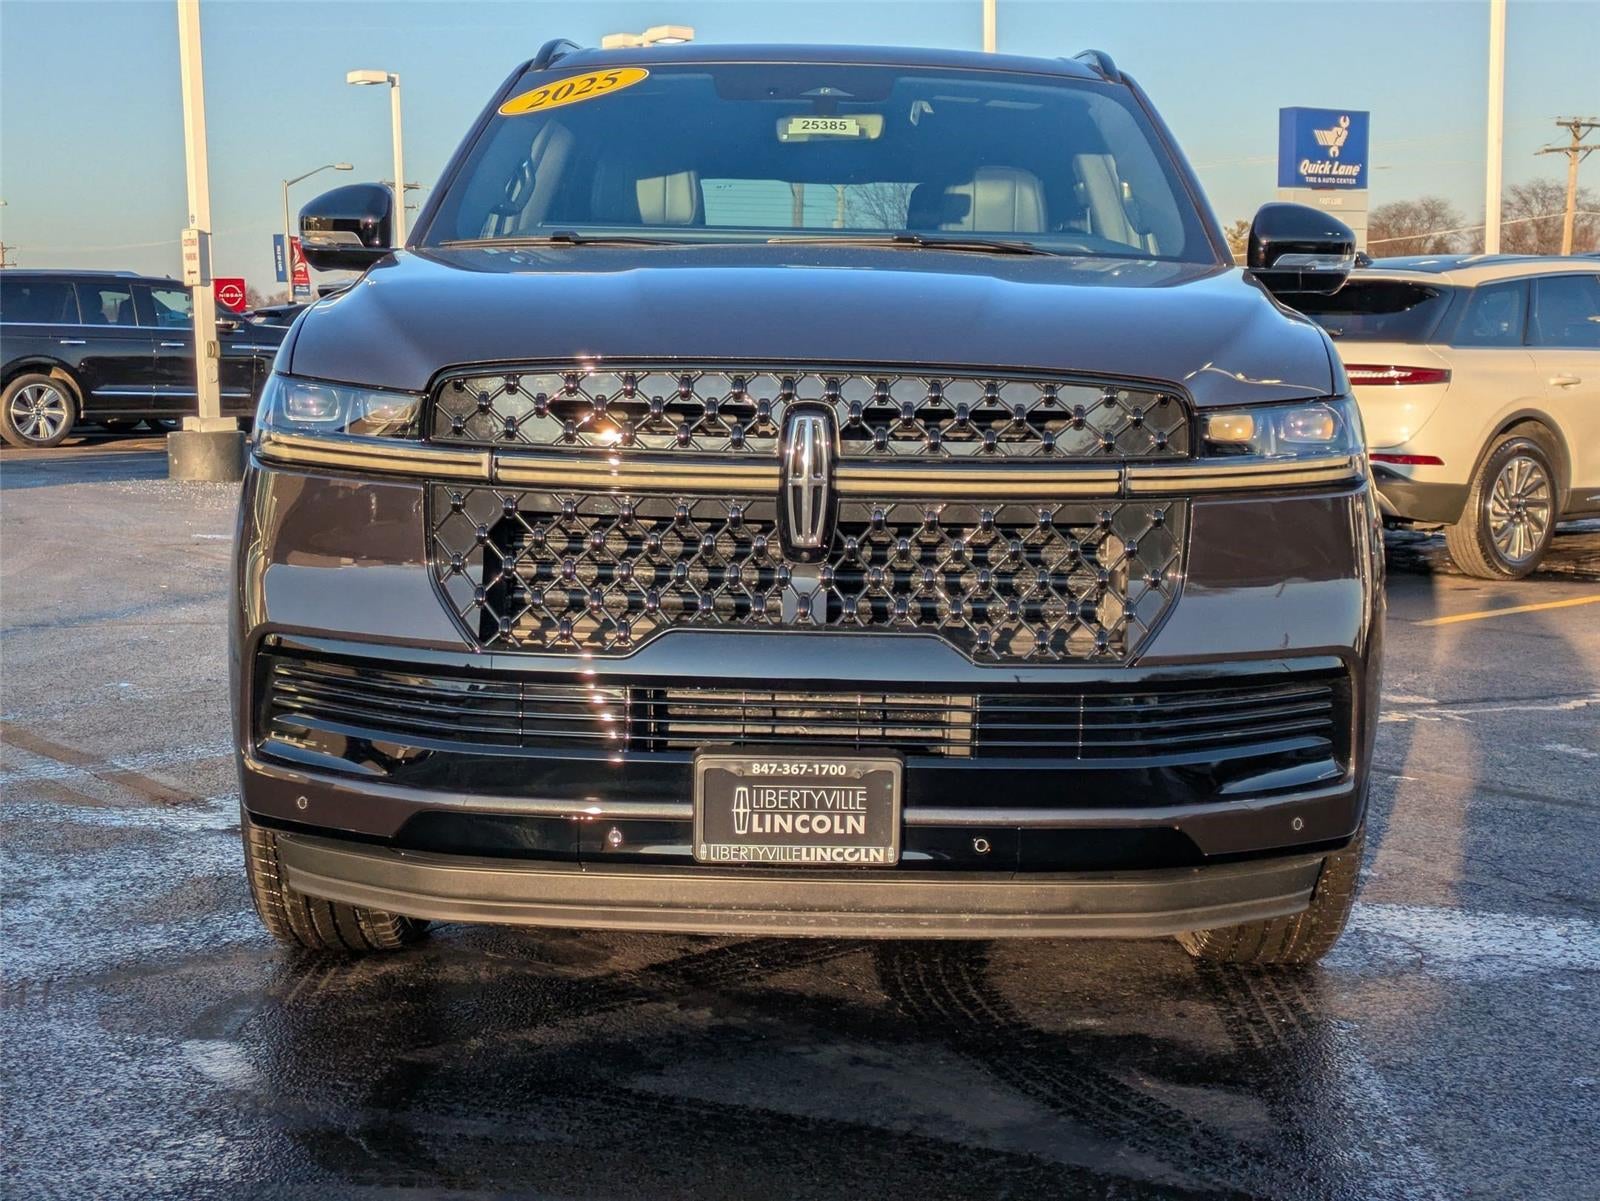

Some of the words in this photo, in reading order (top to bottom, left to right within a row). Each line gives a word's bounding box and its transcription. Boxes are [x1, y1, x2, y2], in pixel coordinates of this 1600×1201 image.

[526, 71, 623, 109] 2025
[801, 120, 848, 131] 25385
[1300, 159, 1331, 175] Quick
[1331, 161, 1360, 176] Lane
[752, 763, 847, 776] 847-367-1700
[752, 789, 867, 810] LIBERTYVILLE
[752, 814, 866, 834] LINCOLN
[710, 845, 800, 861] LIBERTYVILLE
[800, 847, 884, 862] LINCOLN
